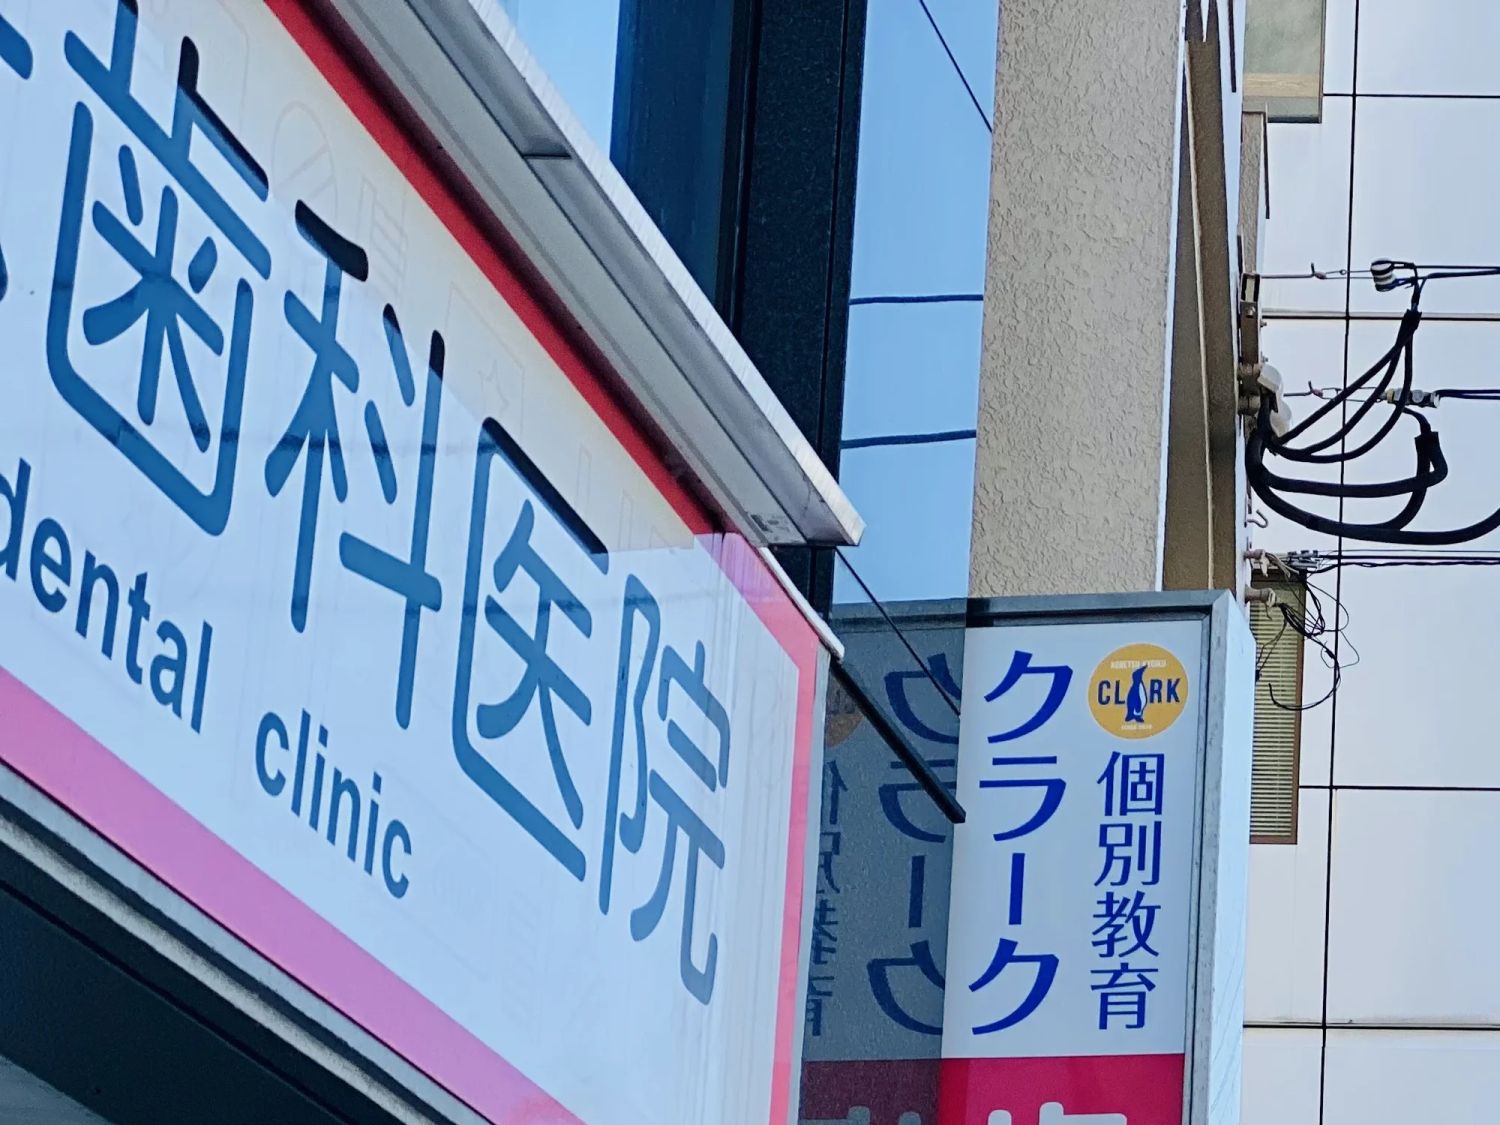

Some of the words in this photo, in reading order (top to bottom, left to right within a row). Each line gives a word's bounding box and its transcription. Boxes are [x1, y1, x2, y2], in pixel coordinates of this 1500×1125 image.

[0, 0, 730, 1005] 歯科医院
[0, 457, 214, 735] dental
[255, 707, 413, 900] clinic
[968, 649, 1074, 1036] クラーク
[1090, 751, 1165, 1031] 個別教育
